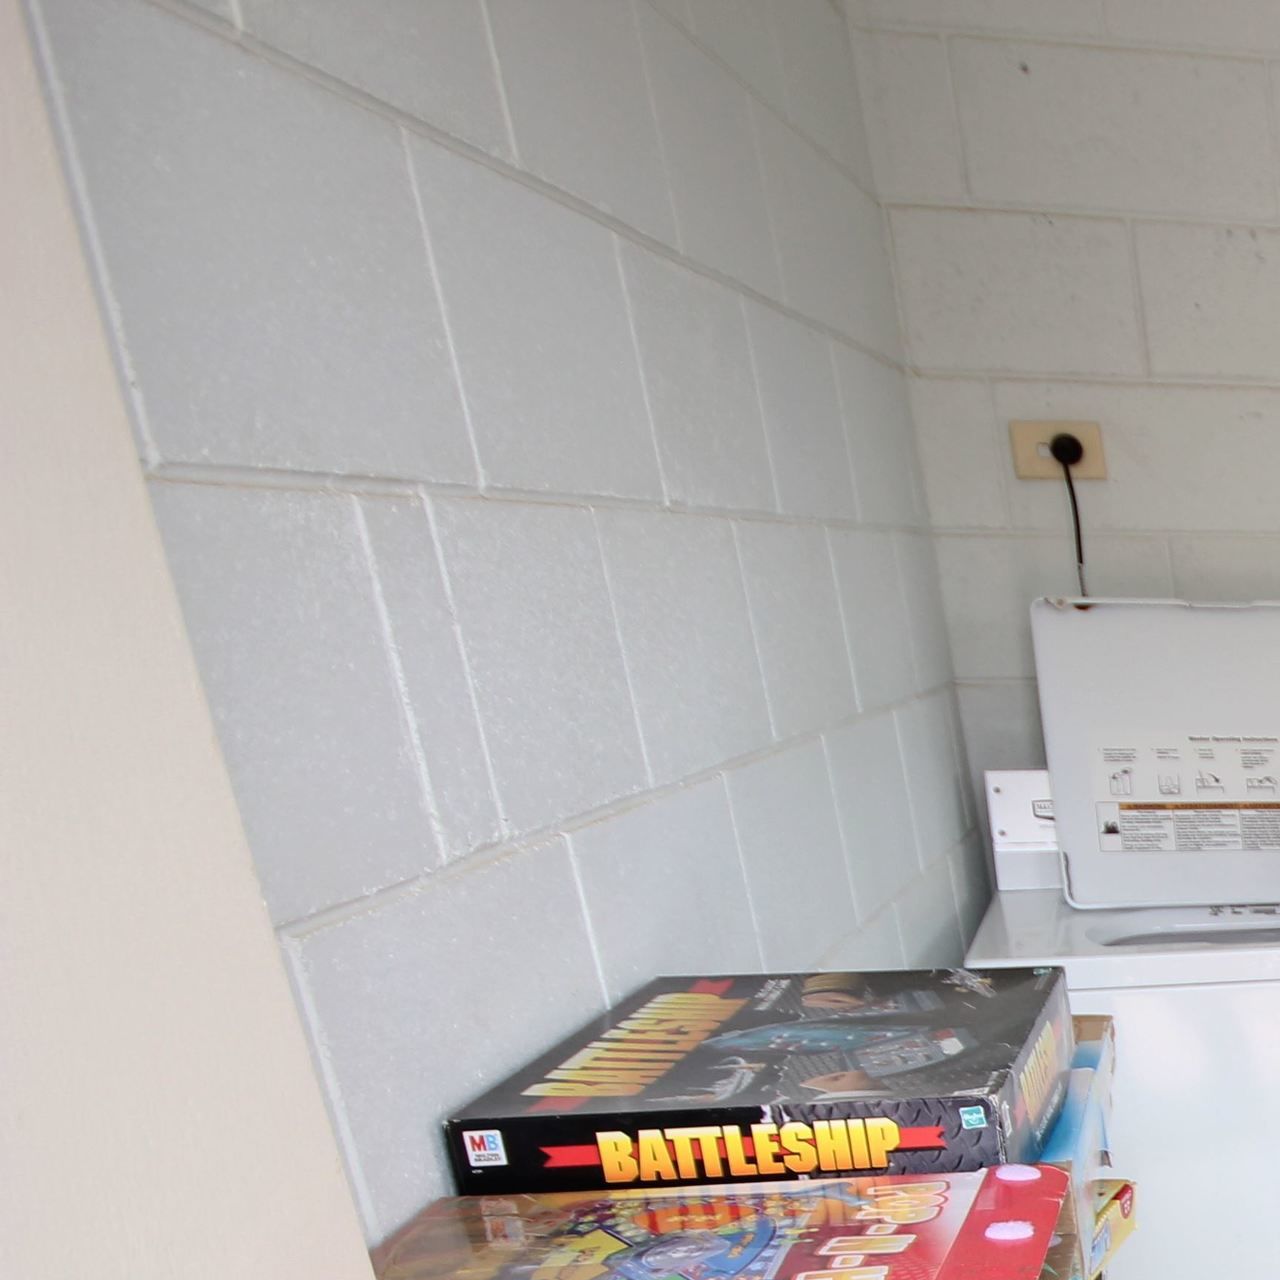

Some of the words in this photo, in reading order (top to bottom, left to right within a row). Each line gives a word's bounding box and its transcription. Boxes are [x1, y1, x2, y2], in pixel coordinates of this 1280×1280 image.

[520, 992, 749, 1097] BATTLESHIP
[469, 1133, 499, 1152] MB
[595, 1117, 900, 1184] BATTLESHIP
